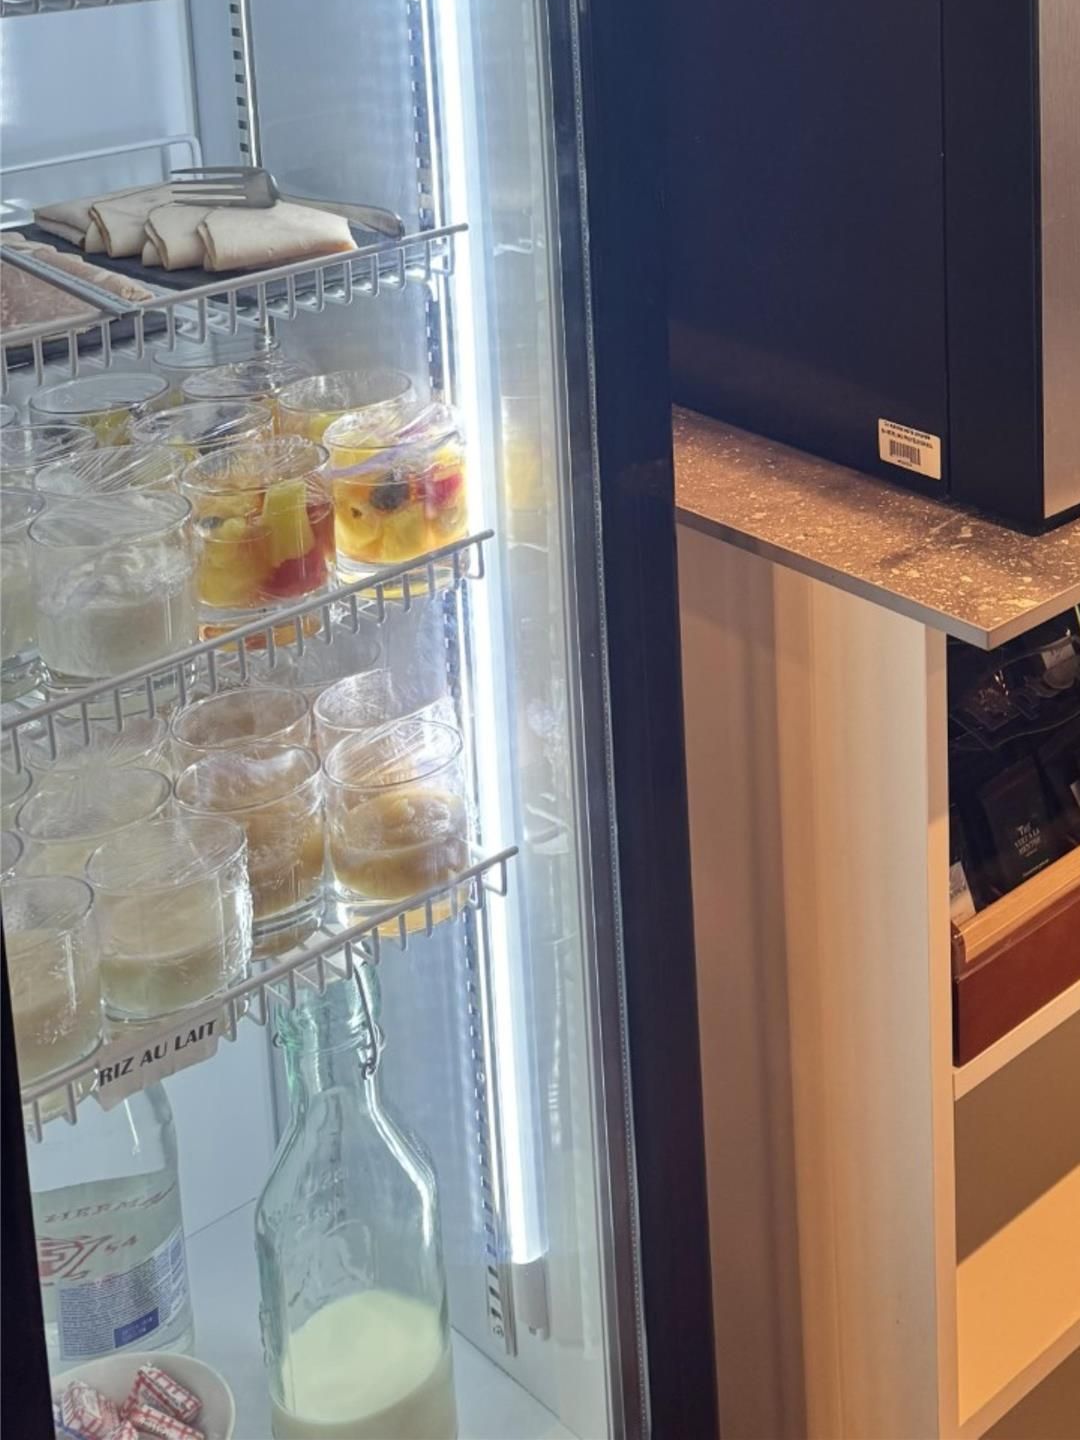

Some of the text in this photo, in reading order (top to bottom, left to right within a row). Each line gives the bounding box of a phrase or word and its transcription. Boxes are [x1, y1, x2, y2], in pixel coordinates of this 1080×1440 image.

[100, 1019, 217, 1087] RIZ AU LAIT
